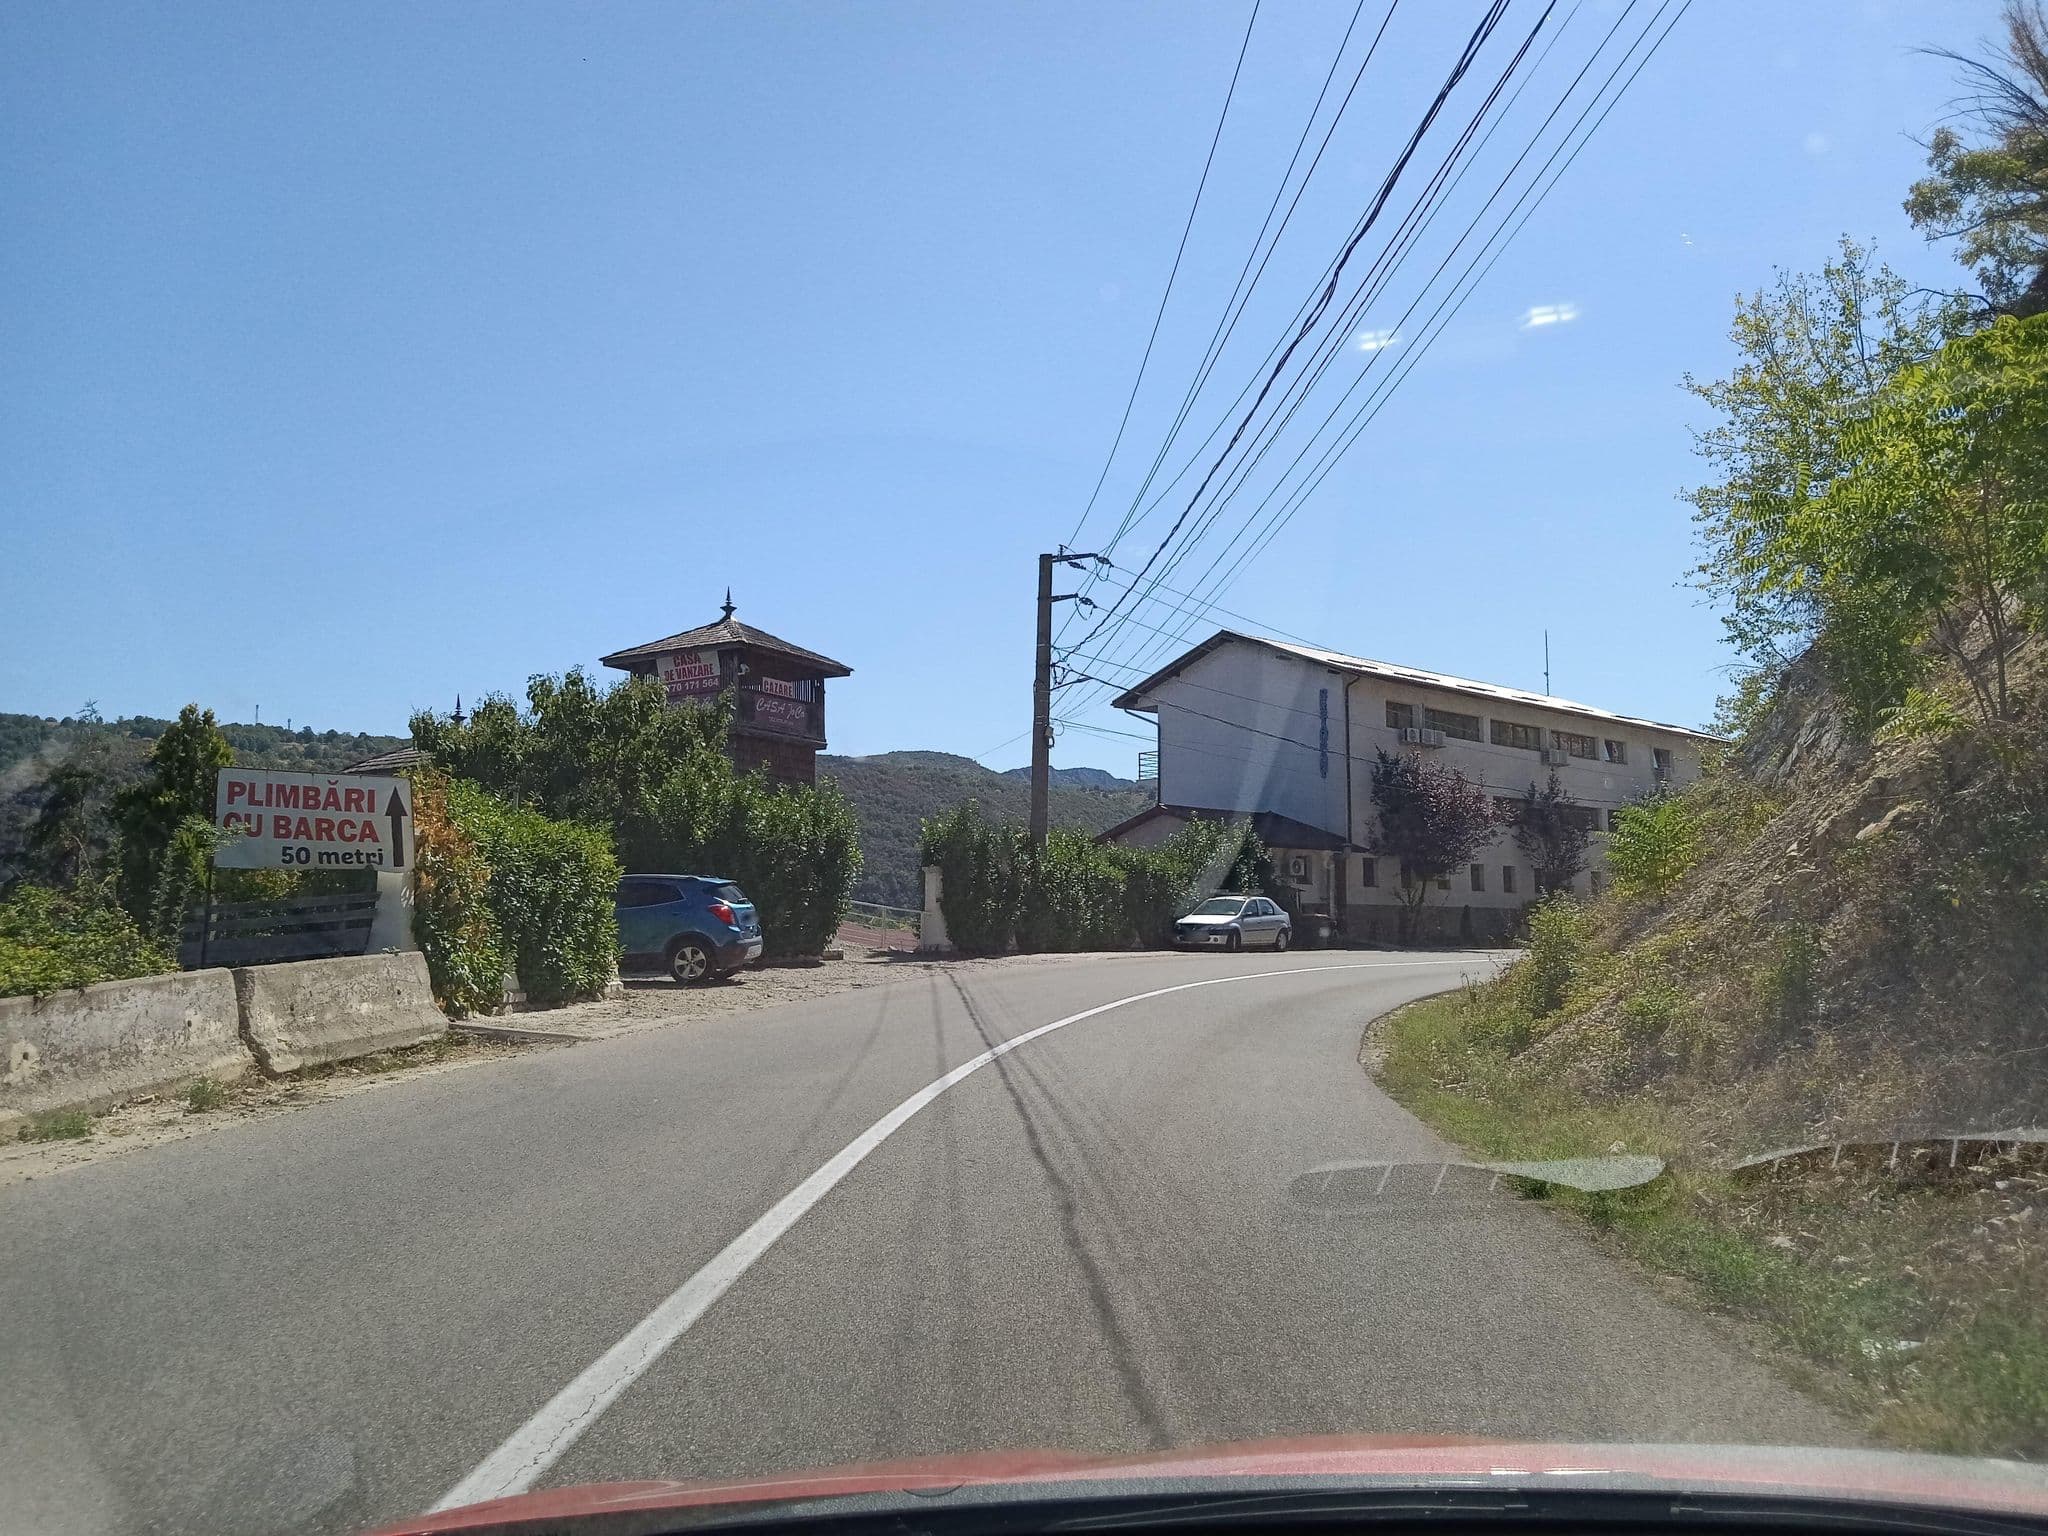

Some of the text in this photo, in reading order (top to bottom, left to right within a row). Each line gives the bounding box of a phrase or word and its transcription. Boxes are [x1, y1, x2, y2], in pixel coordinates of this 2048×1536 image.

[673, 653, 702, 667] CASA
[664, 663, 714, 682] DE VANZARE
[764, 680, 793, 697] CAZARE
[227, 779, 376, 813] PLIMBĂRI
[223, 811, 380, 843] CU BARCA
[281, 846, 384, 866] 50 metri
